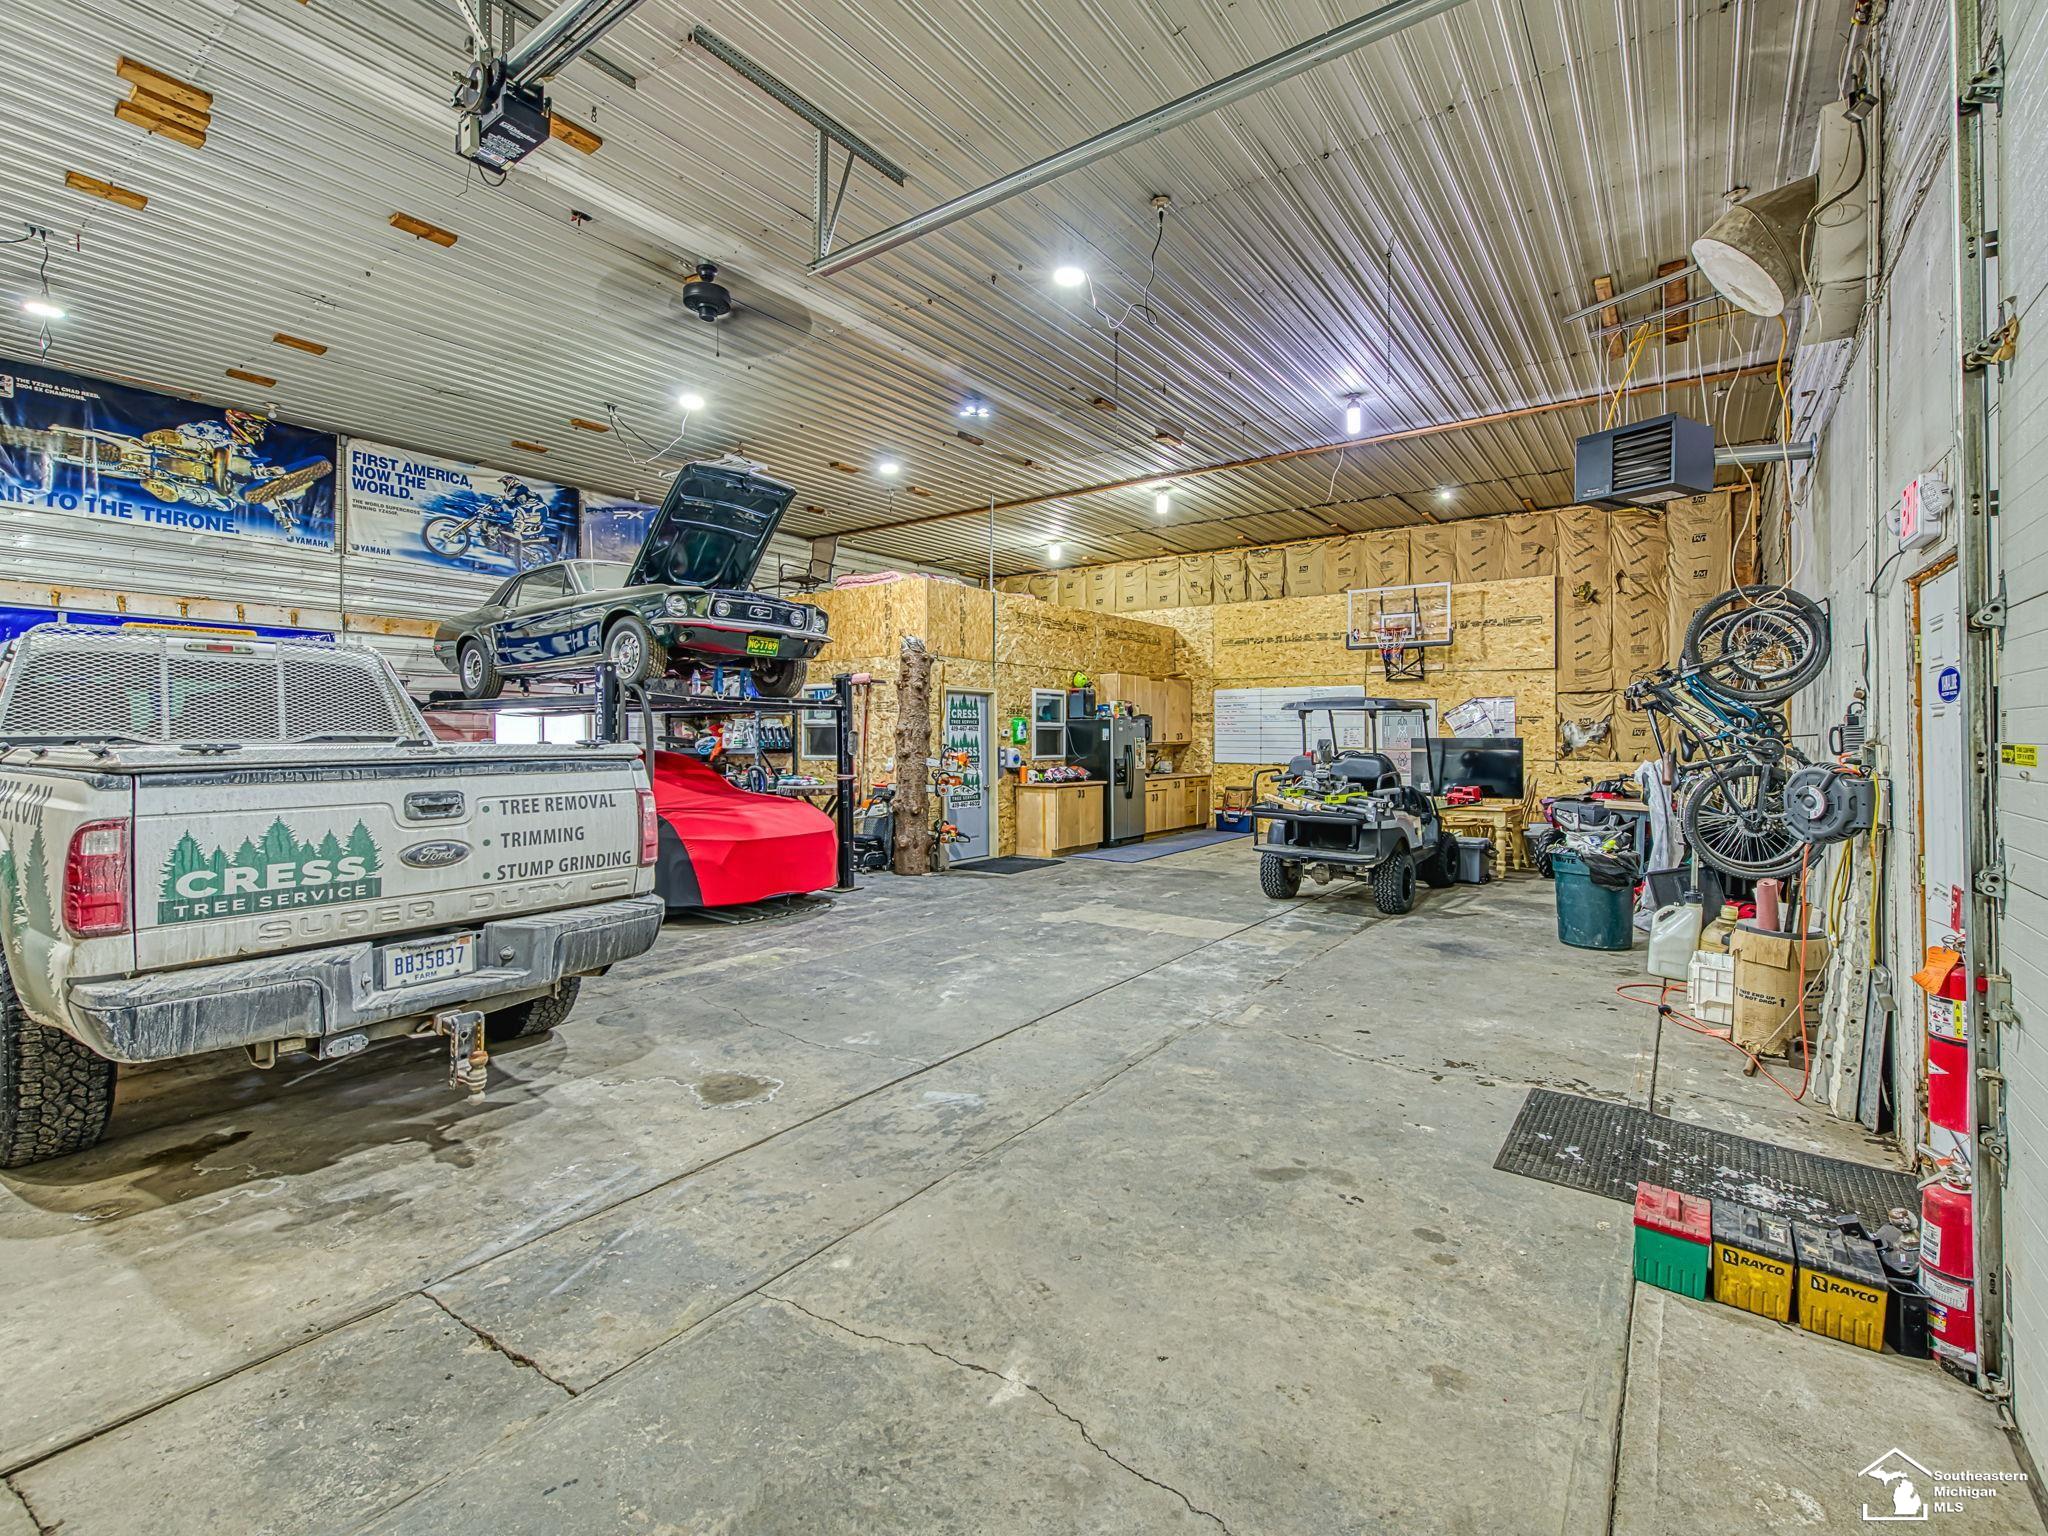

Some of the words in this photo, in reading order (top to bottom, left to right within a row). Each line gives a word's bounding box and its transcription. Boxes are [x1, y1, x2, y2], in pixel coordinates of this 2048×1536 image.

[15, 376, 31, 385] THE
[61, 386, 80, 395] CHAD
[15, 382, 33, 390] 2004
[352, 450, 399, 471] FIRST
[402, 462, 473, 490] AMERICA,
[352, 464, 391, 483] NOW
[394, 472, 427, 490] THE
[351, 477, 414, 501] WORLD.
[47, 491, 78, 511] TO
[84, 494, 133, 519] THE
[140, 505, 240, 535] THRONE.
[352, 503, 377, 512] WINNING
[364, 501, 385, 509] WORLD
[385, 504, 421, 515] SUPERCROSS
[613, 510, 645, 520] FX
[295, 536, 329, 549] YAMAHA
[360, 544, 391, 556] YAMAHA
[951, 708, 978, 719] CRESS
[499, 797, 540, 816] TREE
[544, 793, 616, 812] REMOVAL
[500, 826, 585, 849] TRIMMING
[419, 846, 457, 862] Ford
[496, 860, 554, 881] STUMP
[559, 850, 632, 873] GRINDING
[175, 856, 367, 899] CRESS
[173, 898, 246, 918] TREE
[258, 884, 367, 908] SERVICE
[257, 900, 436, 944] SUPER
[468, 881, 573, 913] DUTY
[394, 945, 465, 976] BB35837
[414, 970, 438, 981] FARM
[1744, 995, 1757, 1003] NOT
[1758, 998, 1777, 1006] DROP
[1740, 1256, 1785, 1276] RAYCO
[1830, 1283, 1879, 1304] RAYCO
